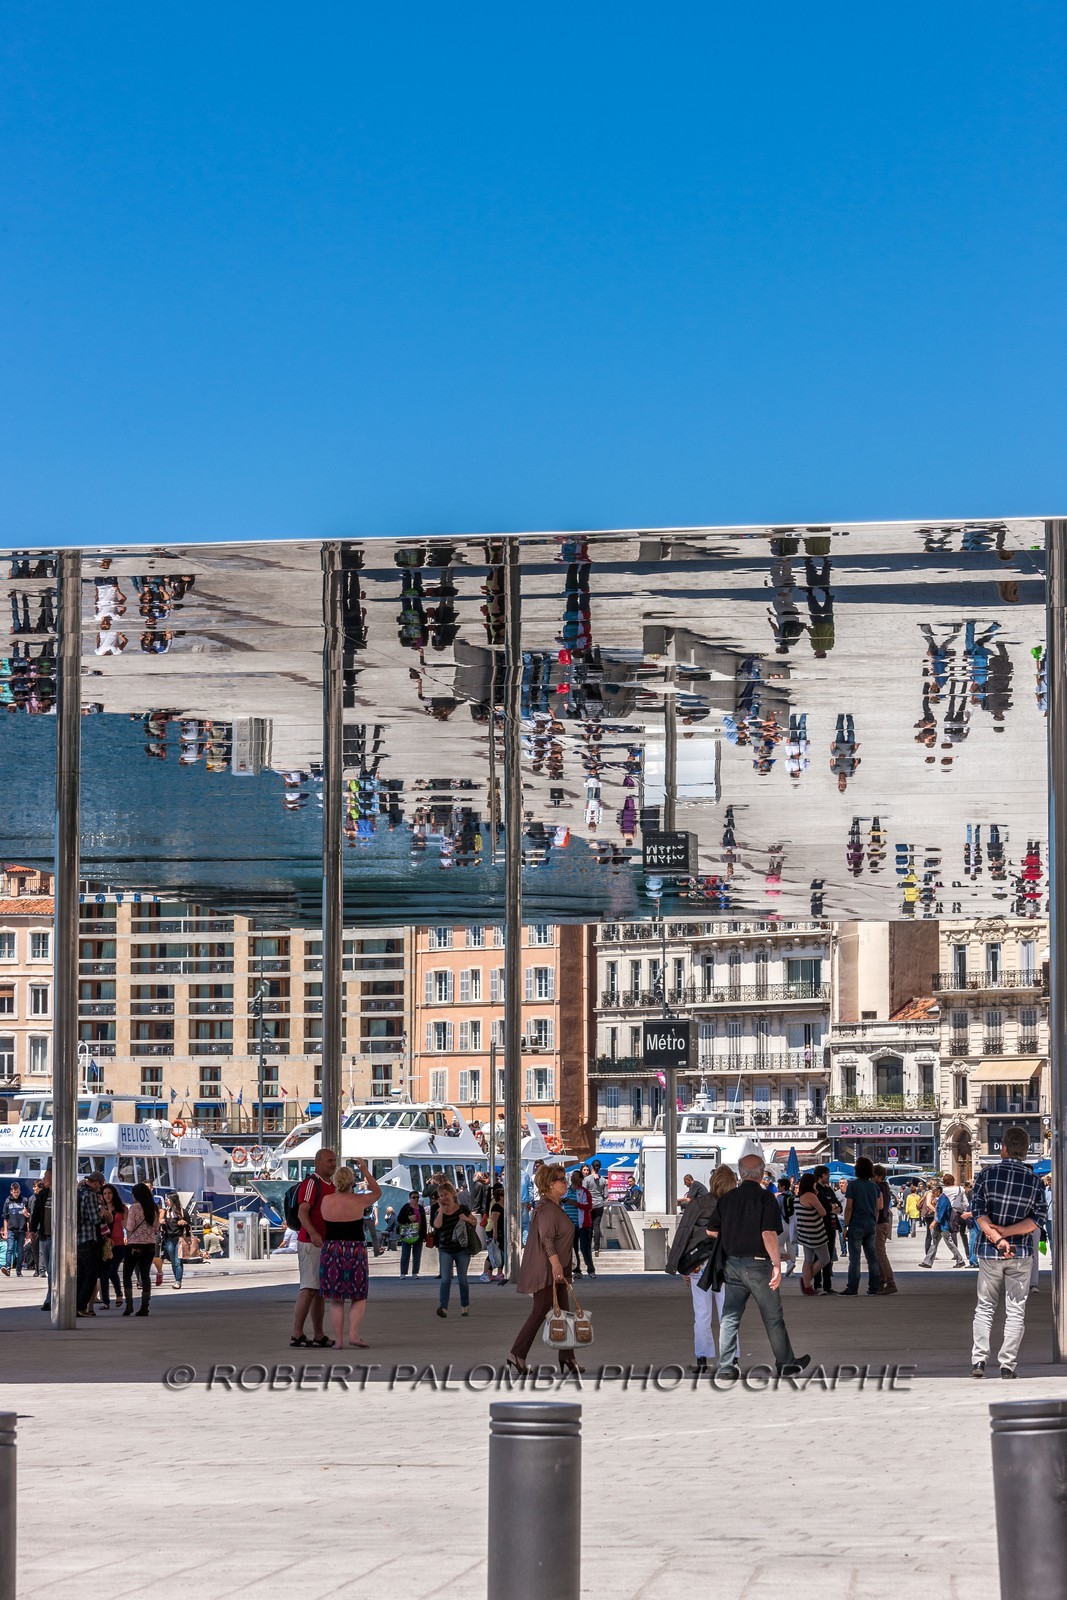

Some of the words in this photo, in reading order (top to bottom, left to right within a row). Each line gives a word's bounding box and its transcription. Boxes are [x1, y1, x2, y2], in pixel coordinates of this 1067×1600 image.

[646, 1033, 685, 1050] Métro
[121, 1127, 150, 1142] HELIOS
[839, 1124, 849, 1133] Le
[850, 1124, 874, 1134] Petit
[878, 1123, 920, 1134] Pernod
